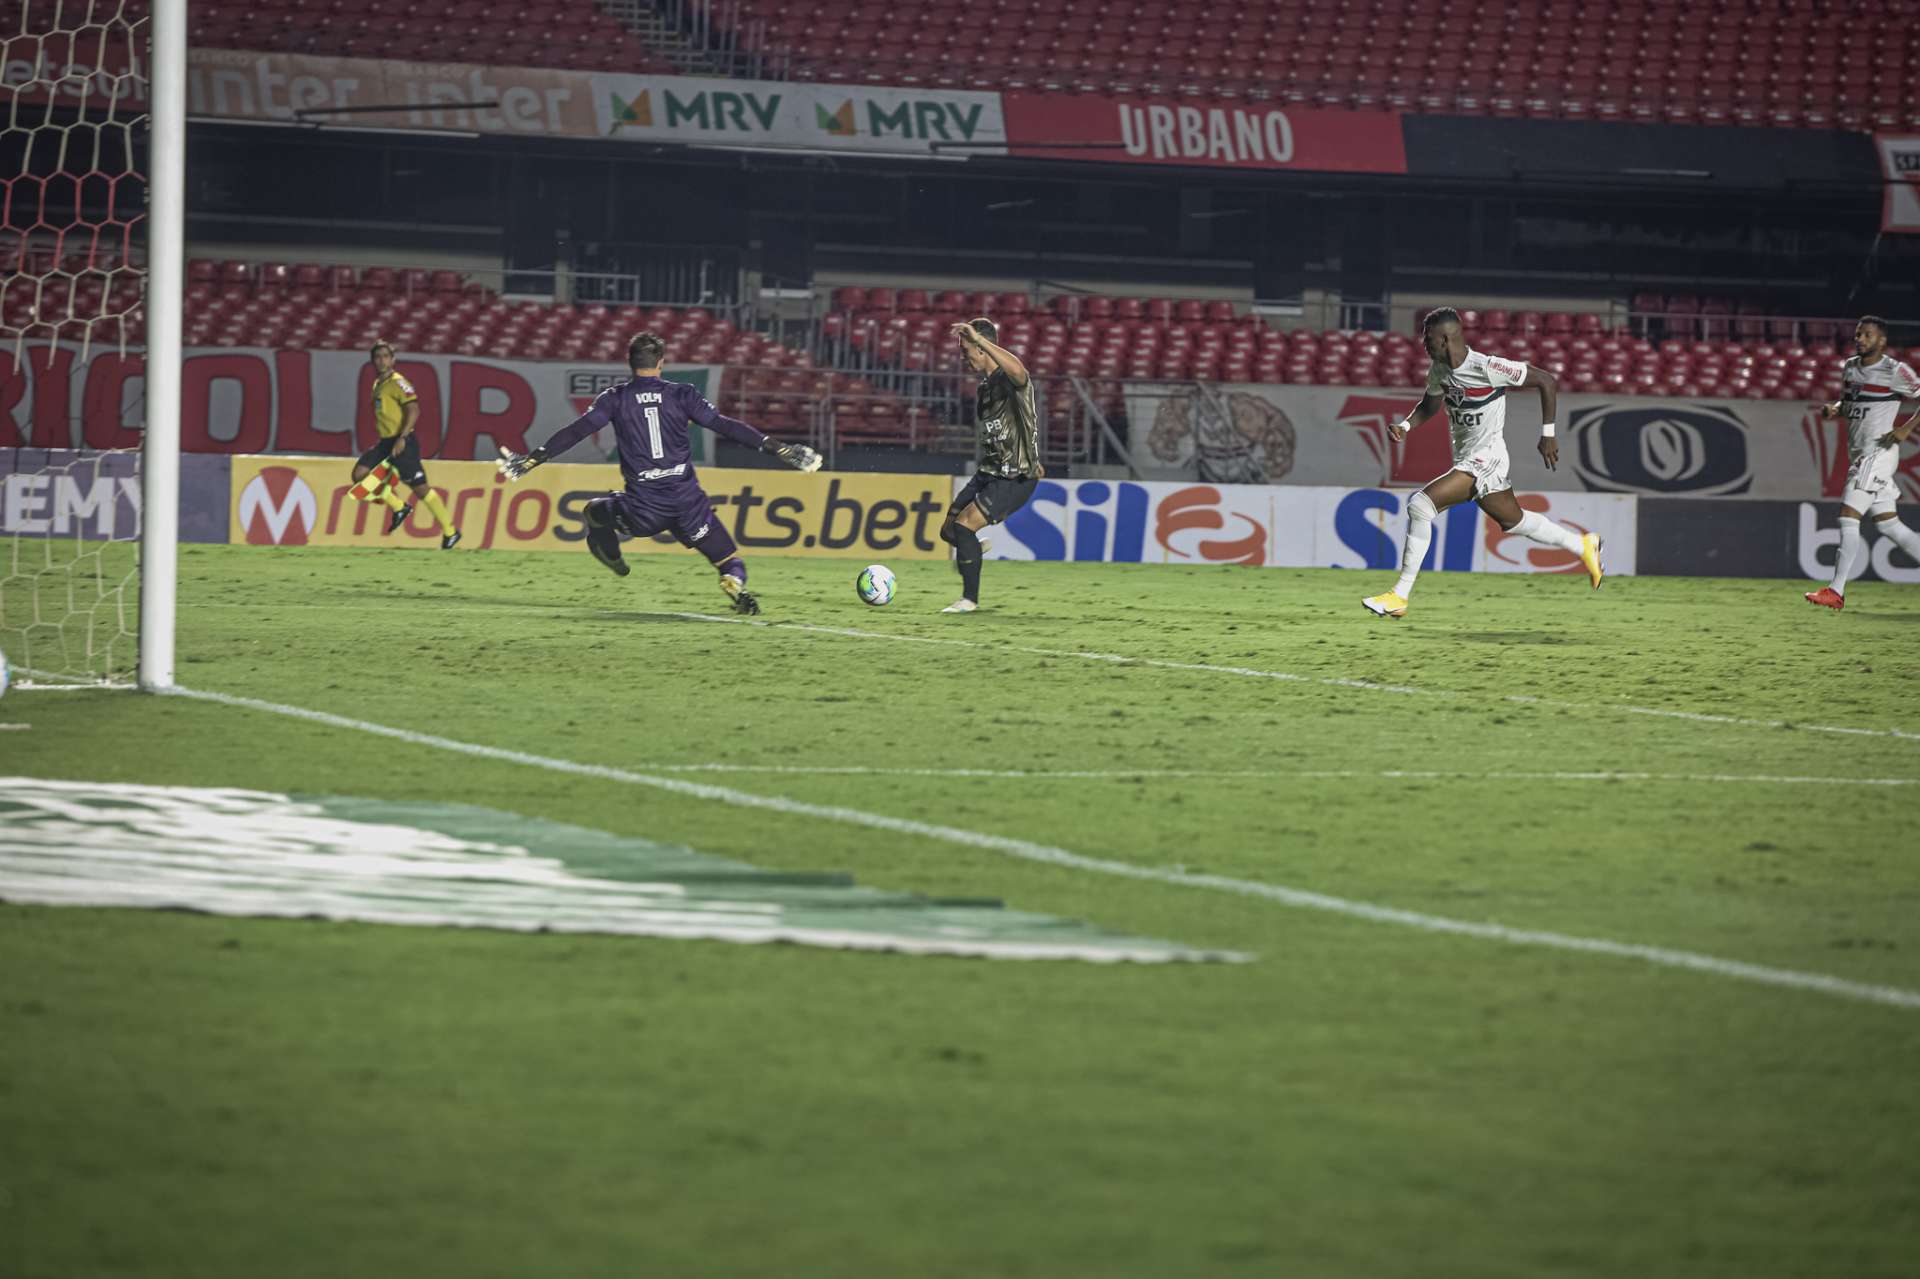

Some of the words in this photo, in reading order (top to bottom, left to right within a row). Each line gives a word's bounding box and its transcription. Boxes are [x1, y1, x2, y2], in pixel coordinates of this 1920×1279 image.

[189, 56, 360, 121] inter
[405, 70, 572, 133] inter
[663, 88, 782, 131] MRV
[866, 99, 984, 141] MRV
[1118, 104, 1293, 162] URBANO
[635, 393, 662, 404] VOLPI
[643, 407, 665, 459] 1
[325, 472, 942, 550] marjosts.bet
[1331, 489, 1479, 571] Sl
